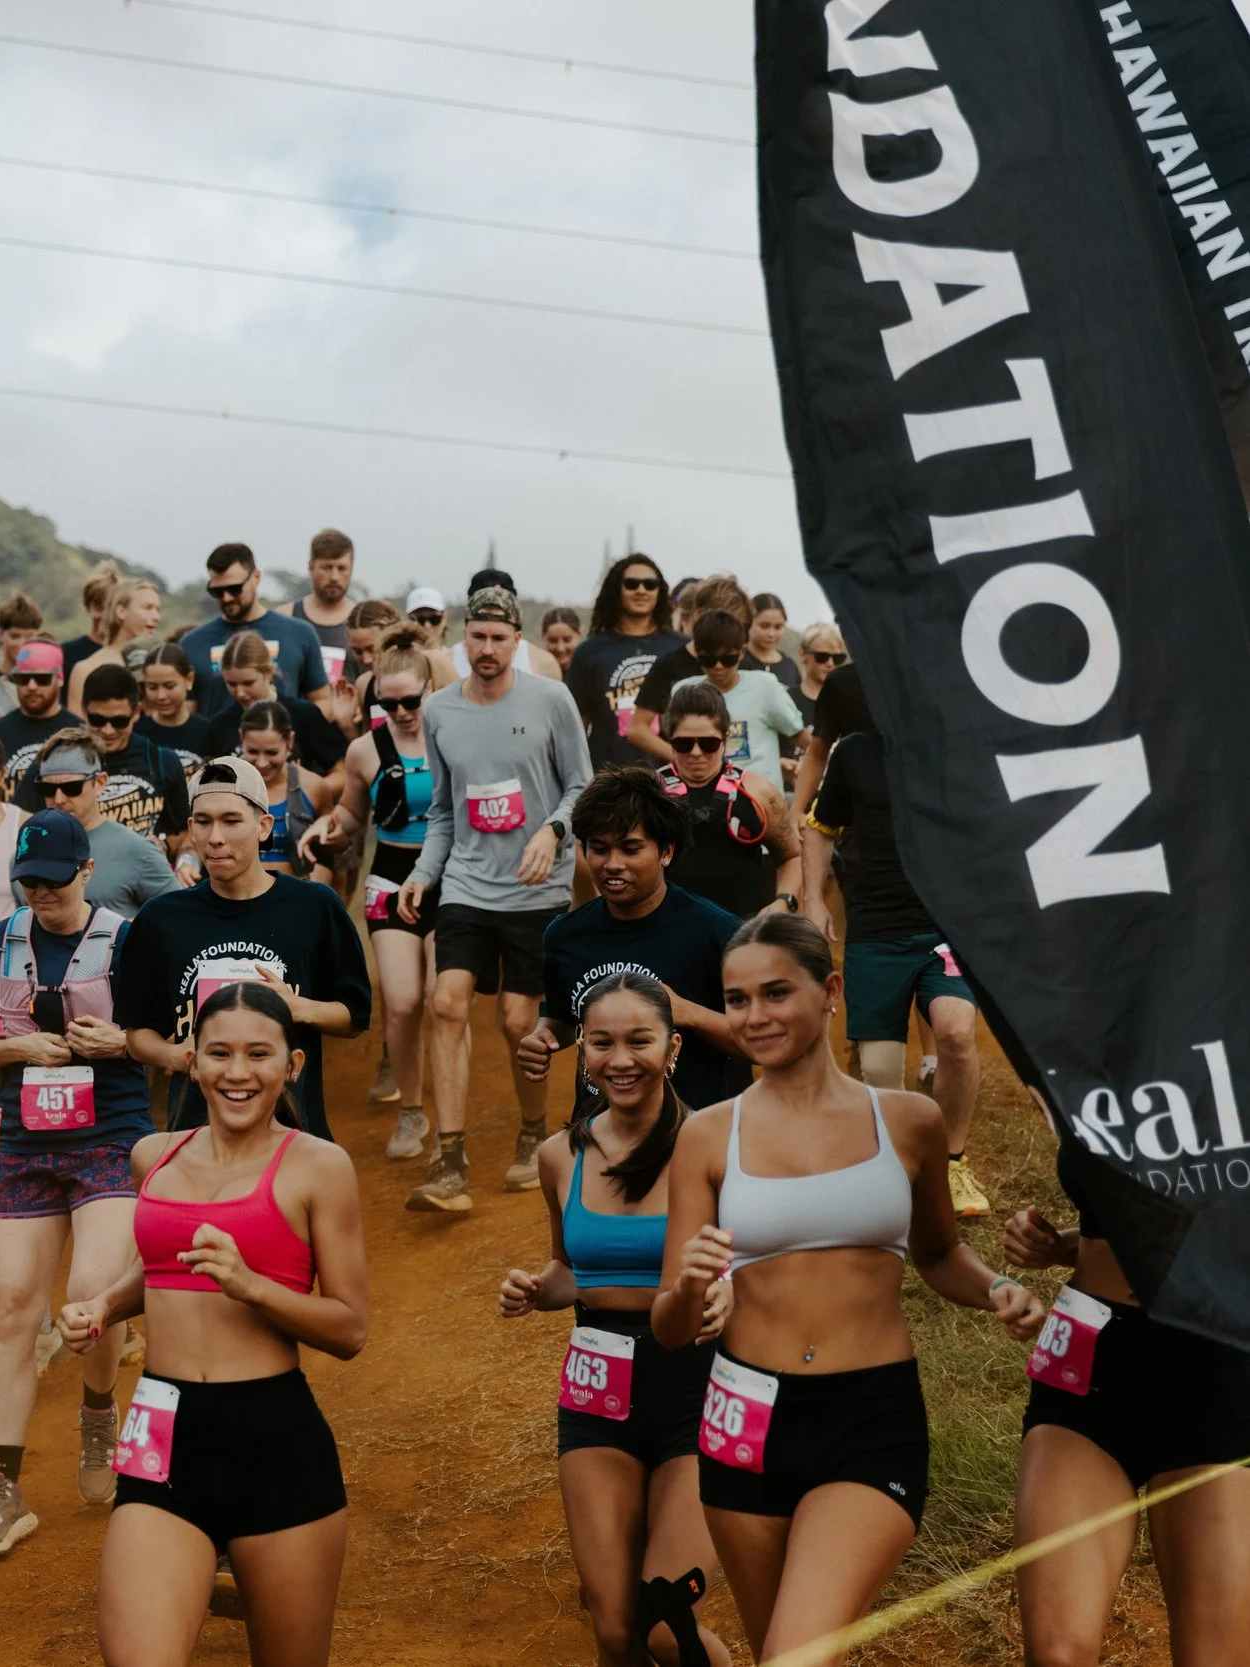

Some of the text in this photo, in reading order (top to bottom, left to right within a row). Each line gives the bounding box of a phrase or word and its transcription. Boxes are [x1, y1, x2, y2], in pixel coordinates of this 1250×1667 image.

[1100, 0, 1250, 281] HAWAIIAN
[478, 797, 511, 818] 402
[36, 1086, 75, 1110] 451
[1037, 1314, 1073, 1357] 83
[565, 1349, 609, 1390] 463
[570, 1385, 594, 1400] Keala
[889, 1482, 906, 1496] alo
